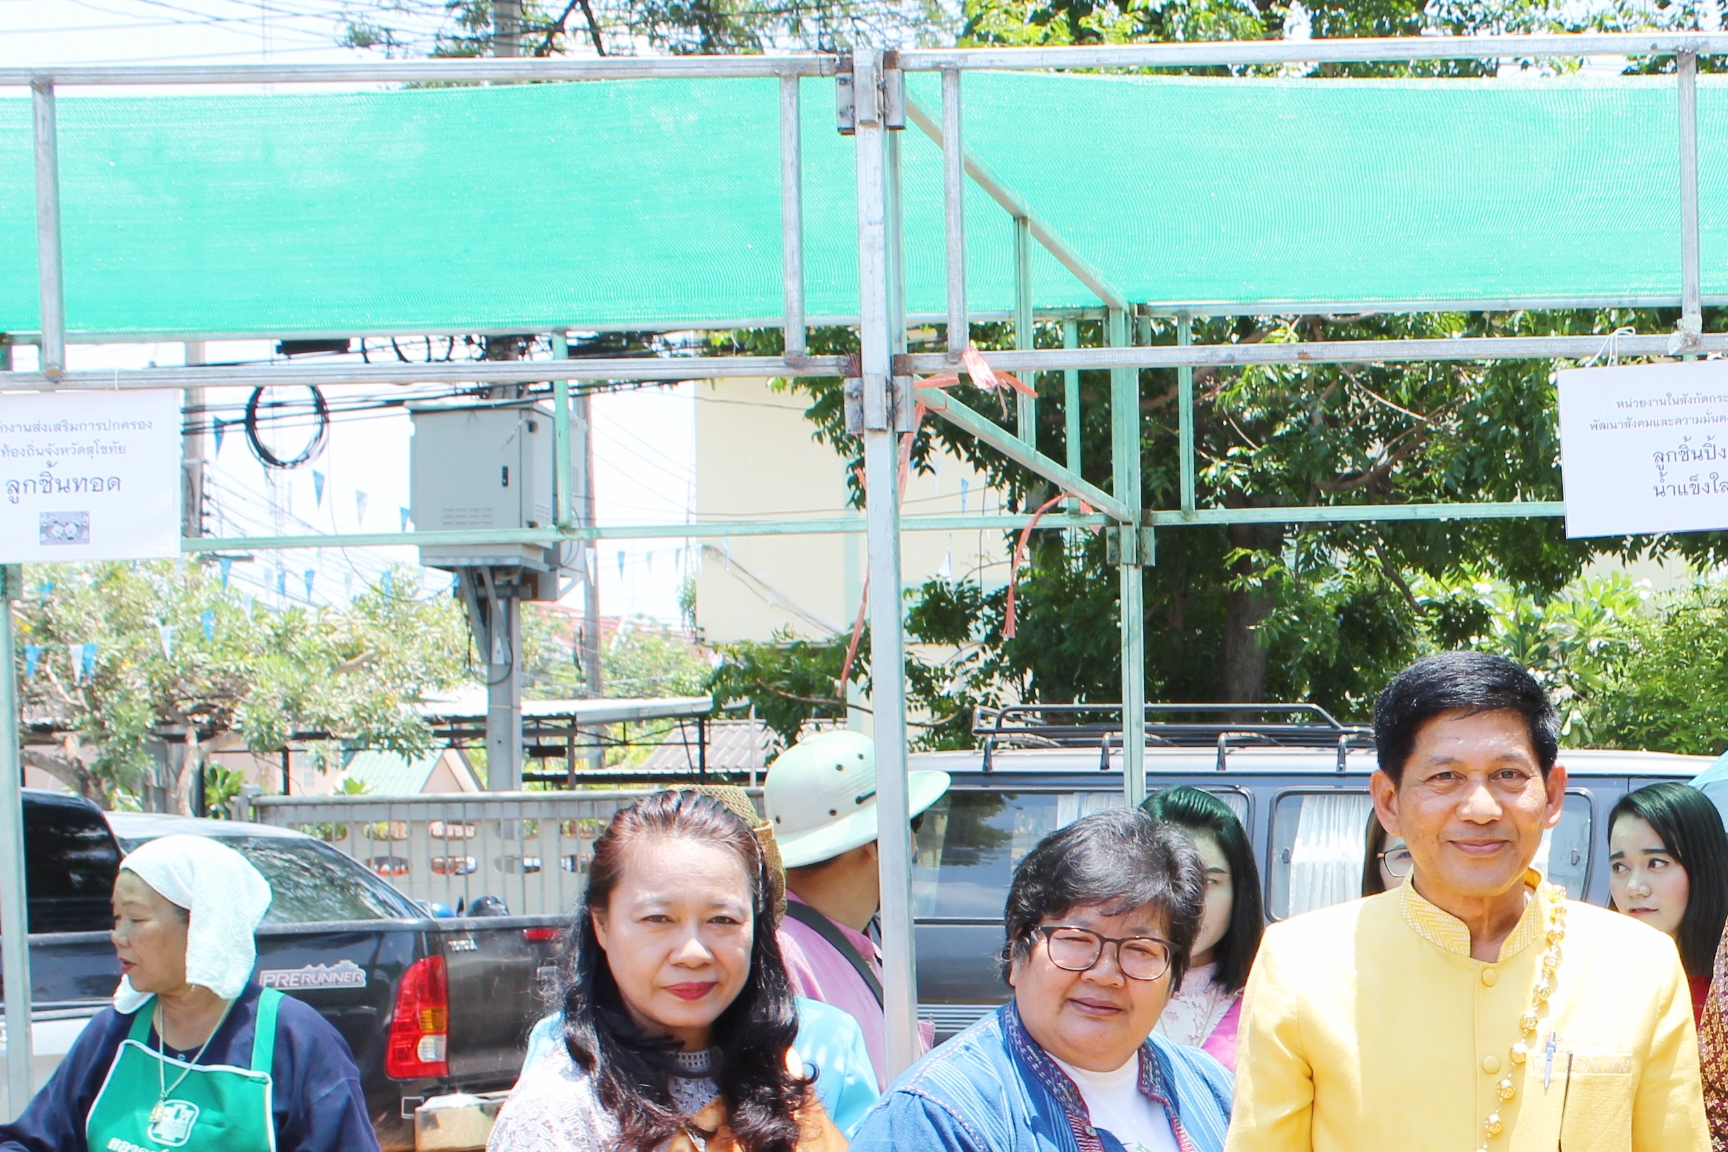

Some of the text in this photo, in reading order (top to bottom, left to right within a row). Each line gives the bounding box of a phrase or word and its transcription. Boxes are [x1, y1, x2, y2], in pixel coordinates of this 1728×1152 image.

[1652, 435, 1727, 470] ลูกชิ้นปิ้ง
[6, 461, 122, 504] ลูกชิ้นทอด
[262, 971, 364, 988] PRERUNNER
